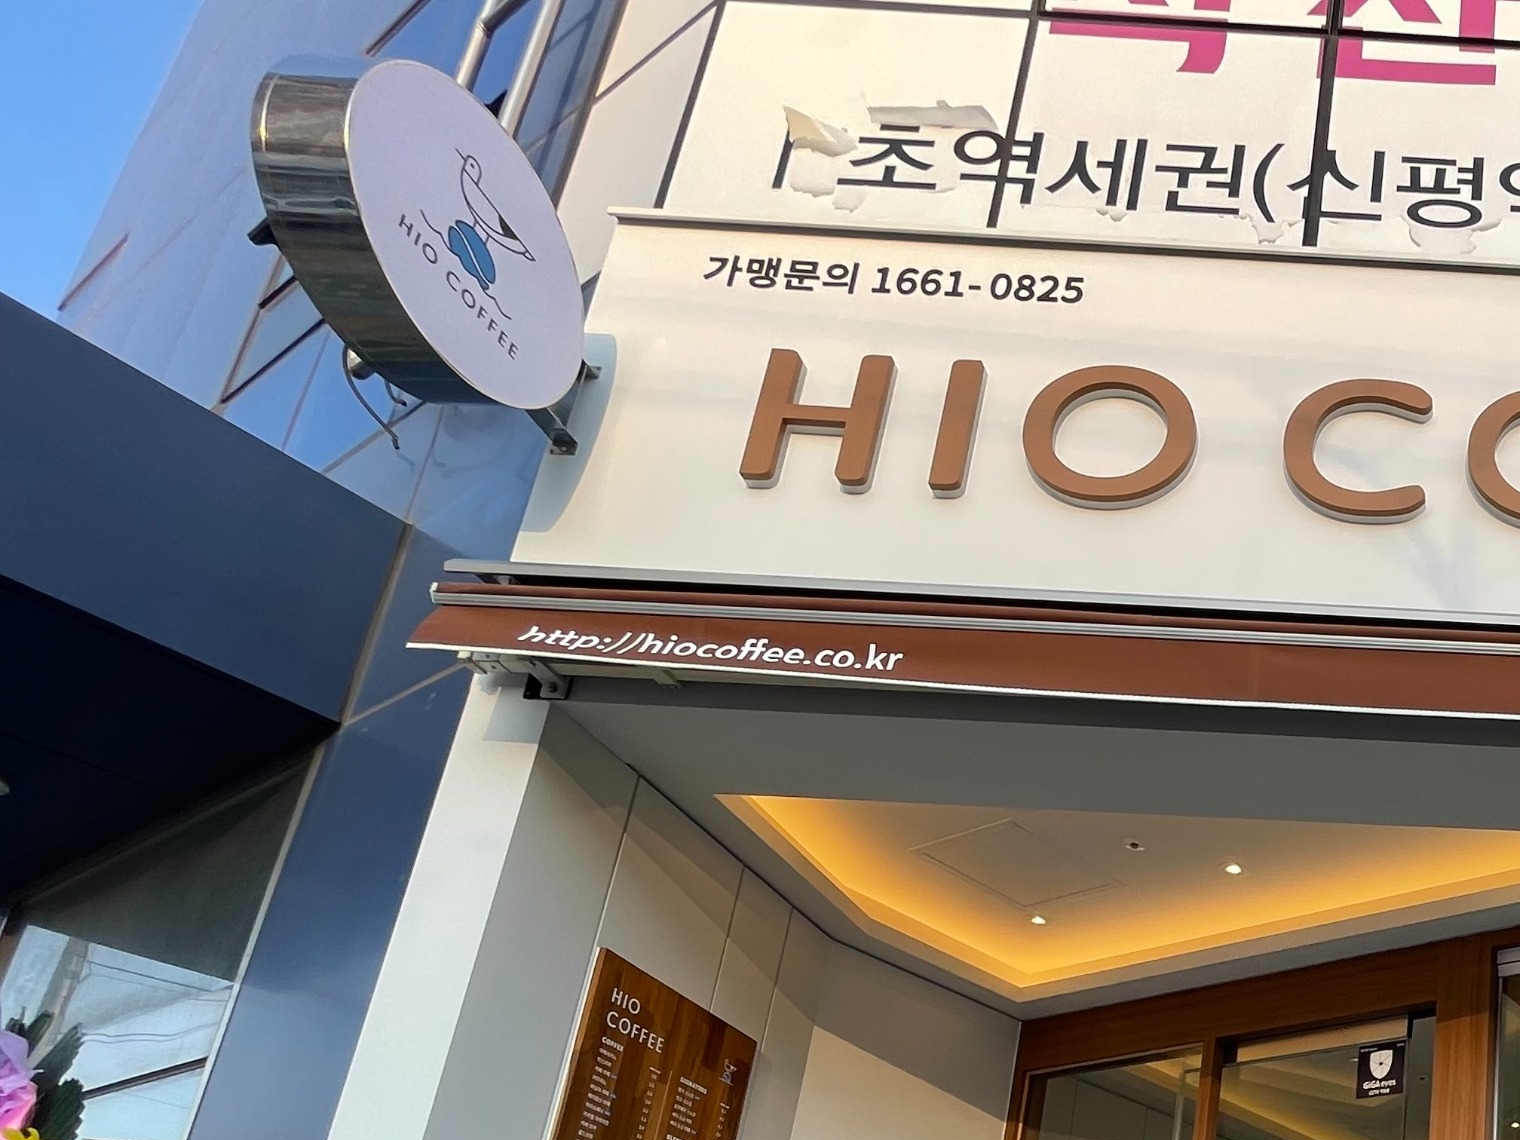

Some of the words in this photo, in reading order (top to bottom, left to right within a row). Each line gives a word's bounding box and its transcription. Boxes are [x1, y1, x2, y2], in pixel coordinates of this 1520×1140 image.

[398, 213, 439, 265] HIO
[445, 270, 520, 361] COFFEE
[703, 252, 860, 295] 가맹문의
[870, 266, 1086, 304] 1661-0825
[738, 347, 1199, 511] HIO
[516, 625, 904, 673] http://hiocoffee.co.kr
[610, 987, 641, 1015] HIO
[606, 1010, 665, 1054] COFFEE
